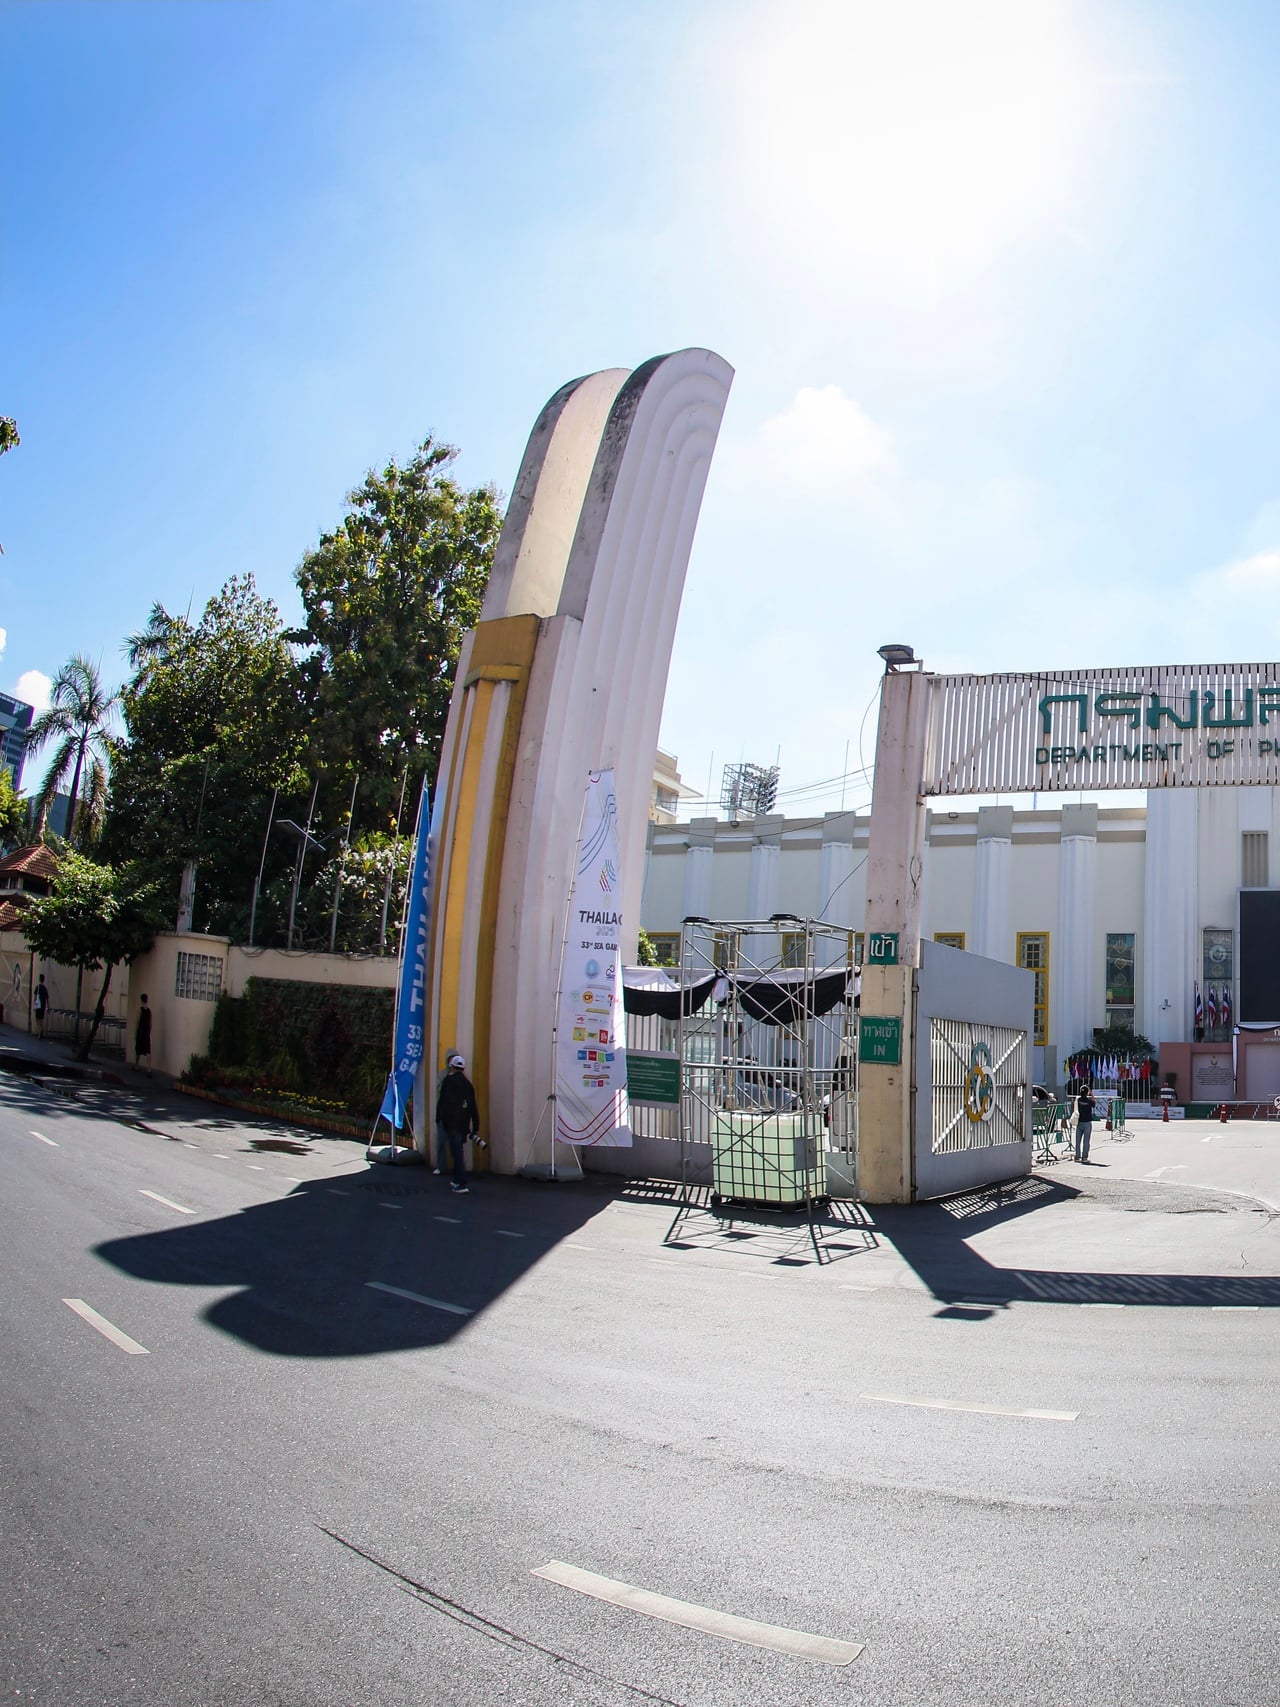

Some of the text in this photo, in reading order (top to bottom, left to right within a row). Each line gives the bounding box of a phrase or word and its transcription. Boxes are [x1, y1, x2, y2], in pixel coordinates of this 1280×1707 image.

[1036, 742, 1183, 765] DEPARTMENT
[1206, 739, 1234, 759] OF
[594, 942, 603, 950] SEA
[870, 934, 896, 957] เข้า
[863, 1021, 898, 1039] ทางเข้า
[873, 1044, 886, 1057] IN
